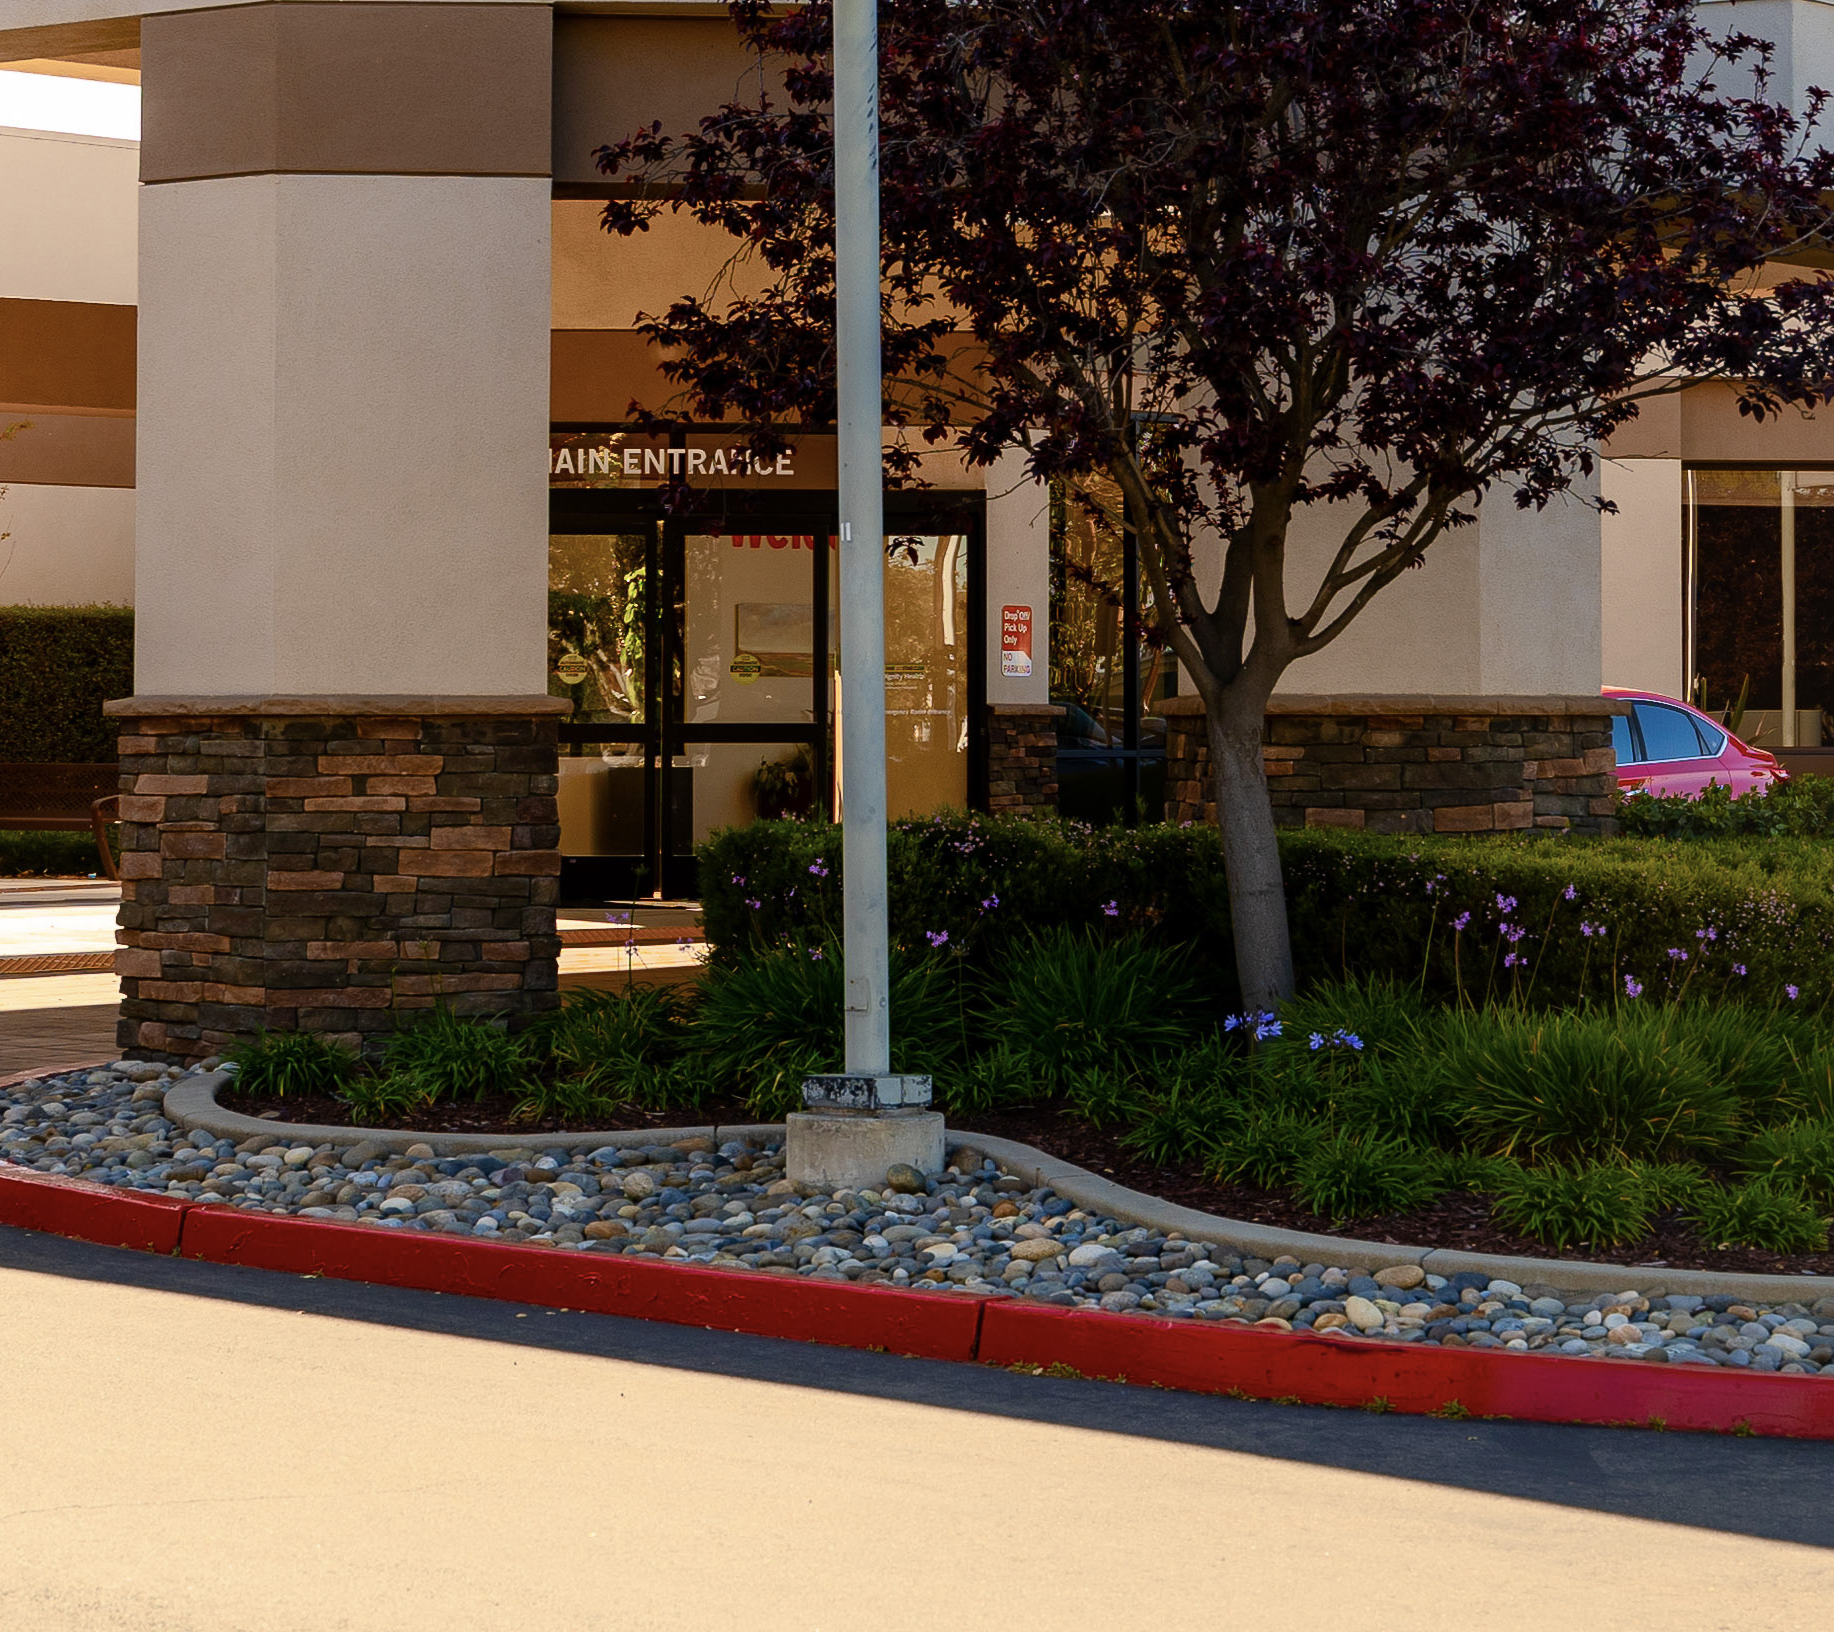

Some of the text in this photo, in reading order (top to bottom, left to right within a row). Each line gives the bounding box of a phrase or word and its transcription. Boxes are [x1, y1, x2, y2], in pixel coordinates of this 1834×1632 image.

[549, 448, 610, 474] AIN
[1004, 623, 1028, 634] Pick Up
[1003, 635, 1017, 646] Only
